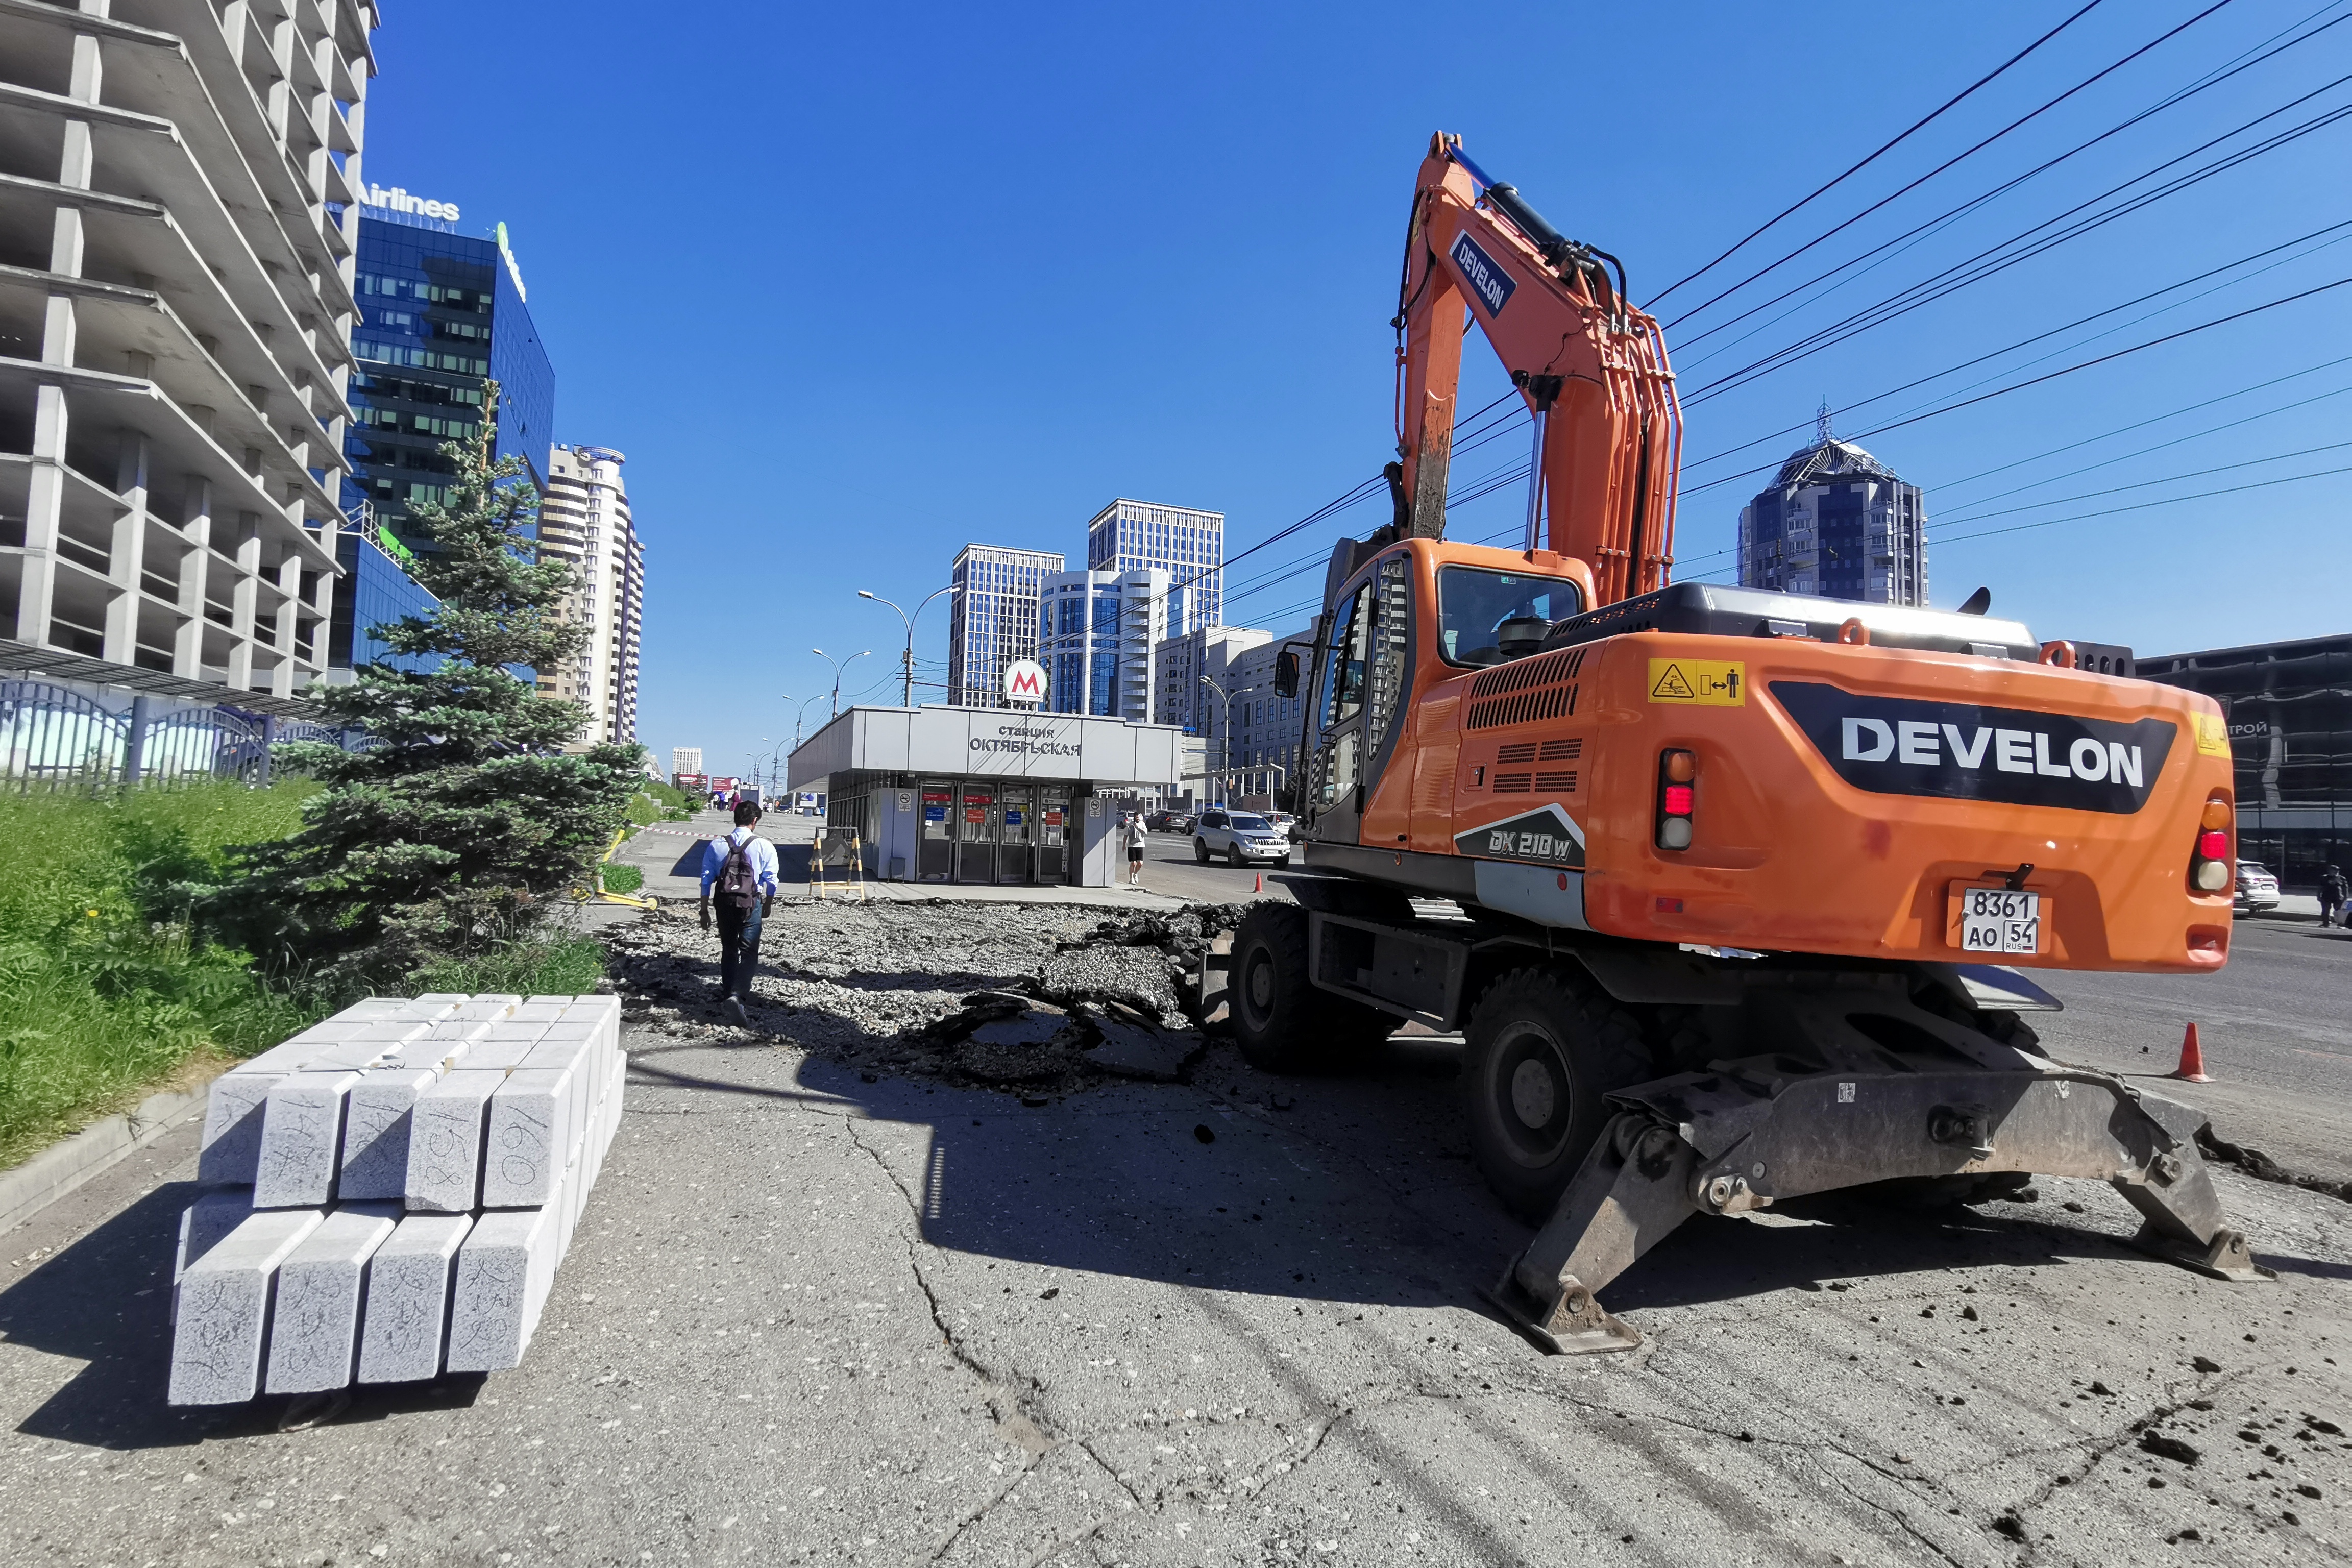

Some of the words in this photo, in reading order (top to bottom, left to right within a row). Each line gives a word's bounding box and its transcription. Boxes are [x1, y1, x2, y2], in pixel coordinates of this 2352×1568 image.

[358, 178, 459, 221] Airlines
[1458, 242, 1504, 310] DEVELON
[1012, 670, 1039, 695] М
[2228, 721, 2267, 734] ТРОЙ
[970, 738, 1082, 756] ОКТЯБРЬСКАЯ
[1842, 717, 2143, 787] DEVELON
[1973, 892, 2029, 919] 8361
[2010, 923, 2031, 943] 54
[426, 1111, 469, 1185] 158
[501, 1105, 548, 1185] 160
